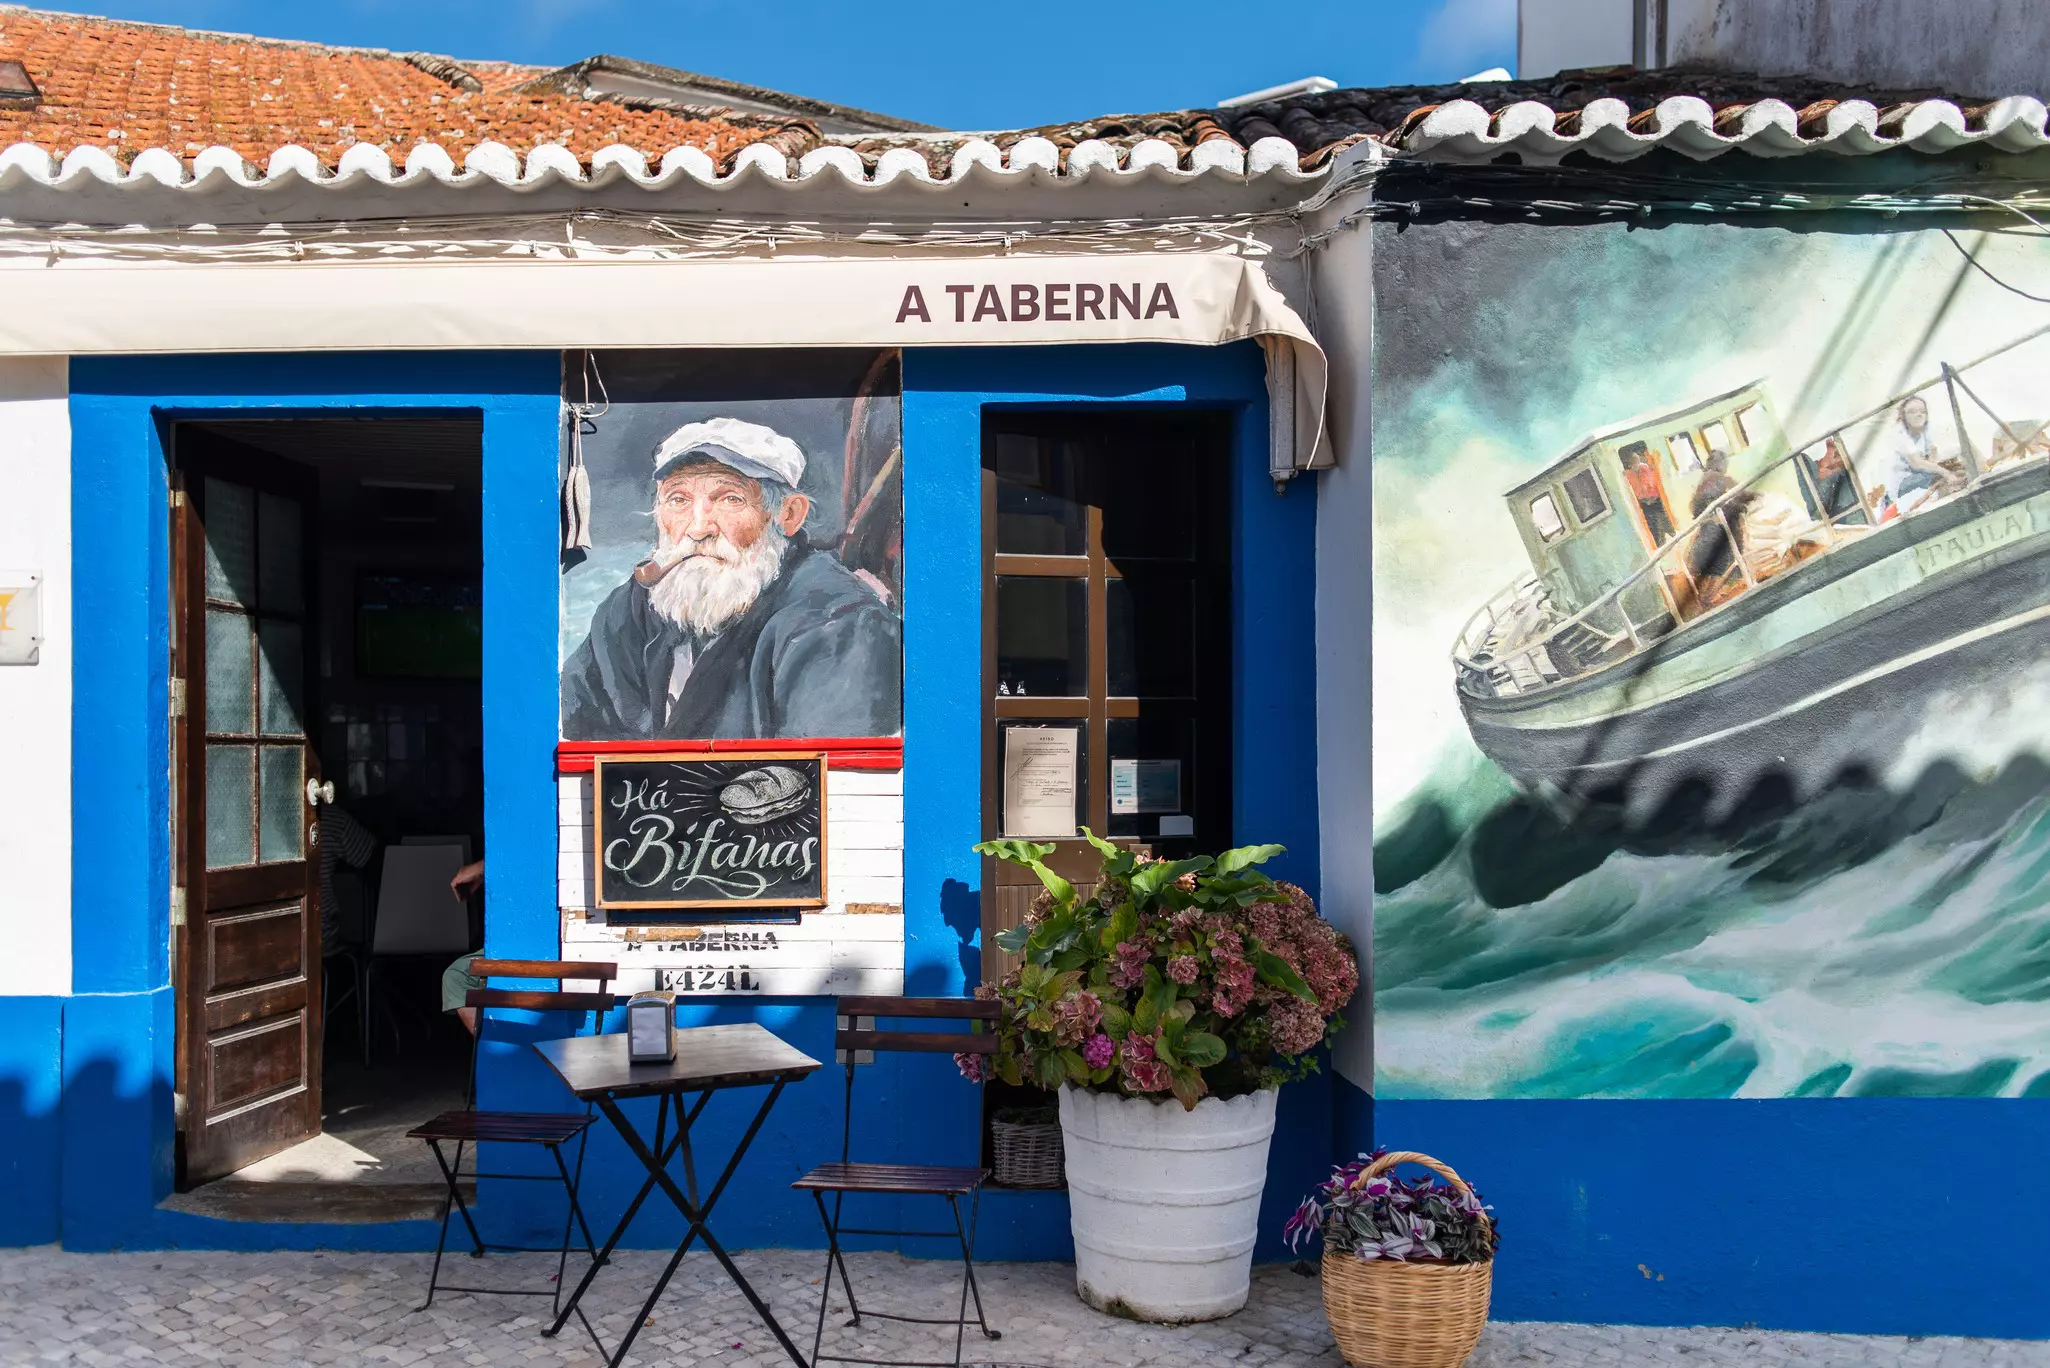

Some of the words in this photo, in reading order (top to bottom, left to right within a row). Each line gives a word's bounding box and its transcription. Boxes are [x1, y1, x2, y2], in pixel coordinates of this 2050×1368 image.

[895, 285, 931, 323] A
[946, 282, 1180, 323] TABERNA
[1925, 514, 2023, 567] PAULA
[610, 778, 675, 820] Há
[604, 814, 819, 899] Bifanas
